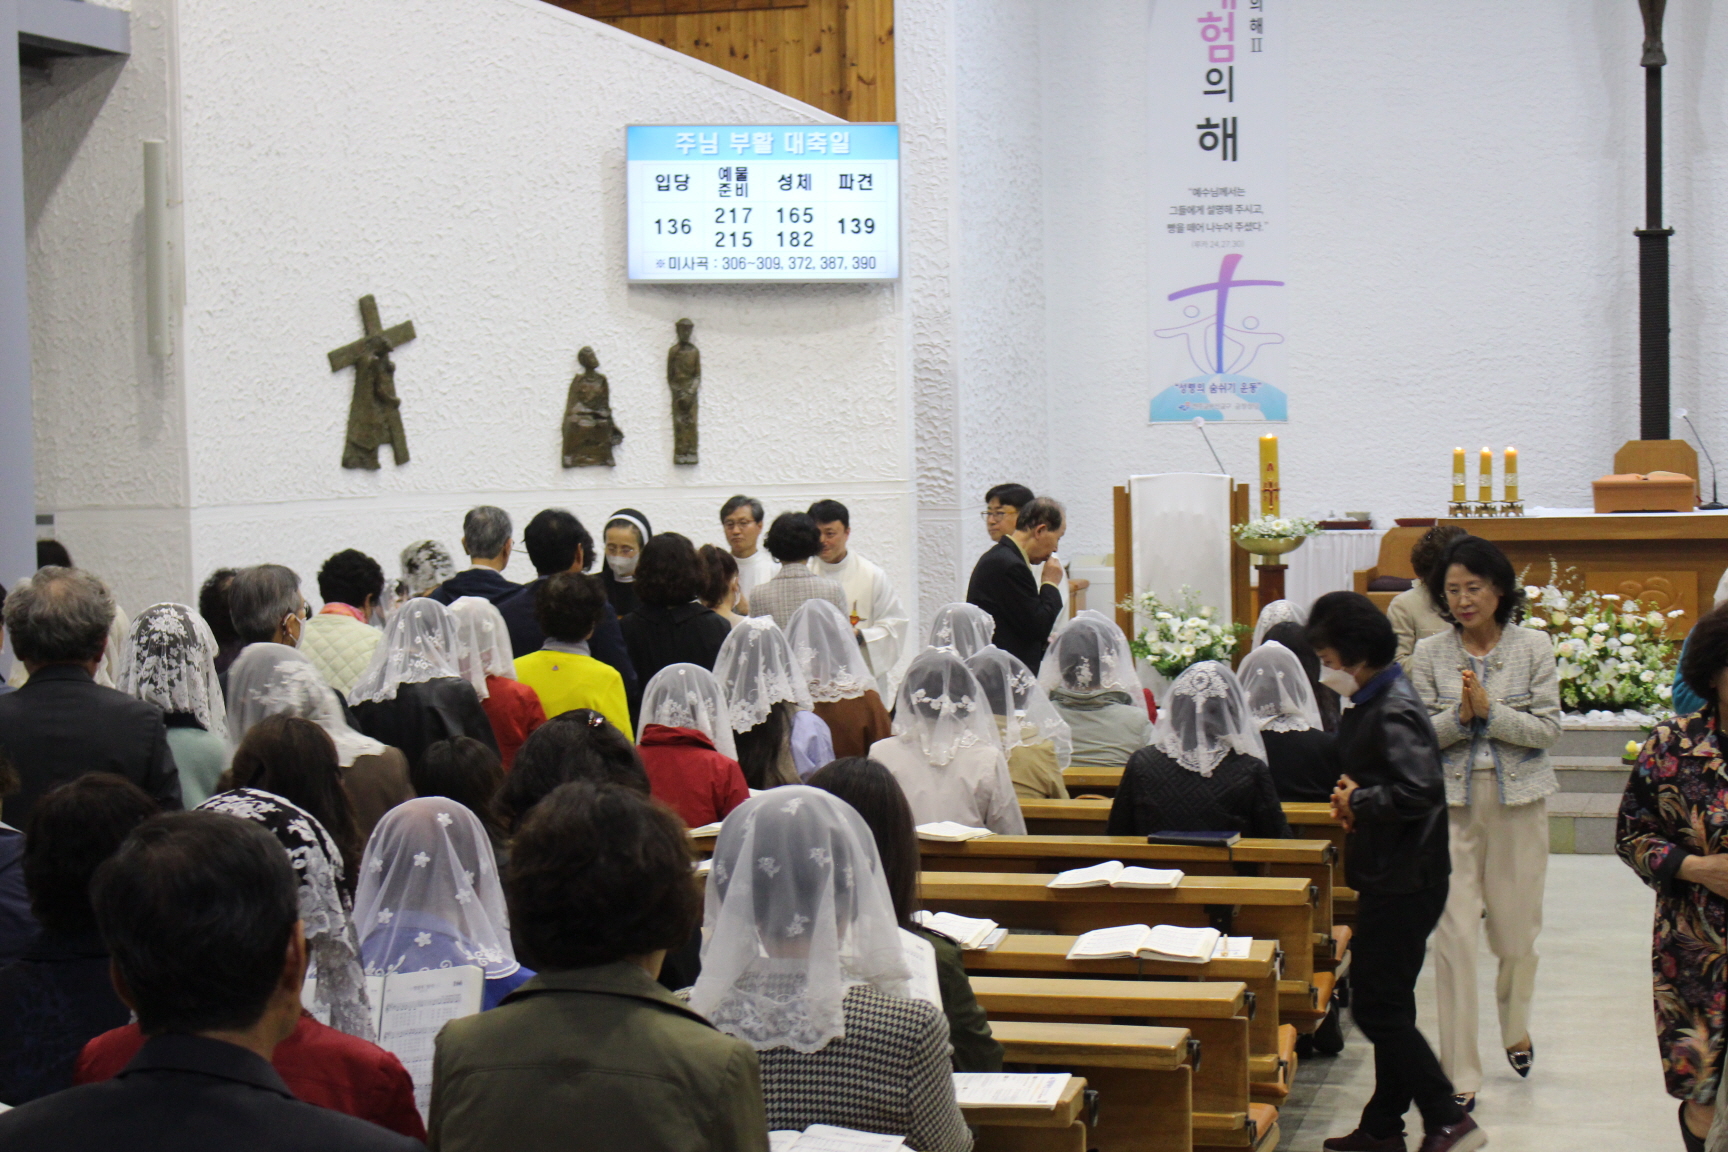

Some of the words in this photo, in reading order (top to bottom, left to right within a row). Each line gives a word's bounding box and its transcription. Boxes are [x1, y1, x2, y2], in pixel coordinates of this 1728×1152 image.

[1250, 17, 1263, 34] 해
[1197, 0, 1237, 103] 험의
[675, 131, 718, 155] 주님
[729, 131, 774, 155] 부활
[784, 131, 851, 155] 대축일
[1196, 116, 1238, 162] 해
[655, 173, 690, 192] 입당
[838, 173, 874, 191] 파견
[718, 166, 749, 182] 예물
[718, 183, 749, 198] 준비
[714, 207, 753, 224] 217
[777, 207, 814, 223] 165
[654, 218, 692, 235] 136
[838, 218, 876, 234] 139
[714, 231, 753, 248] 215
[777, 231, 814, 247] 182
[852, 256, 876, 270] 390
